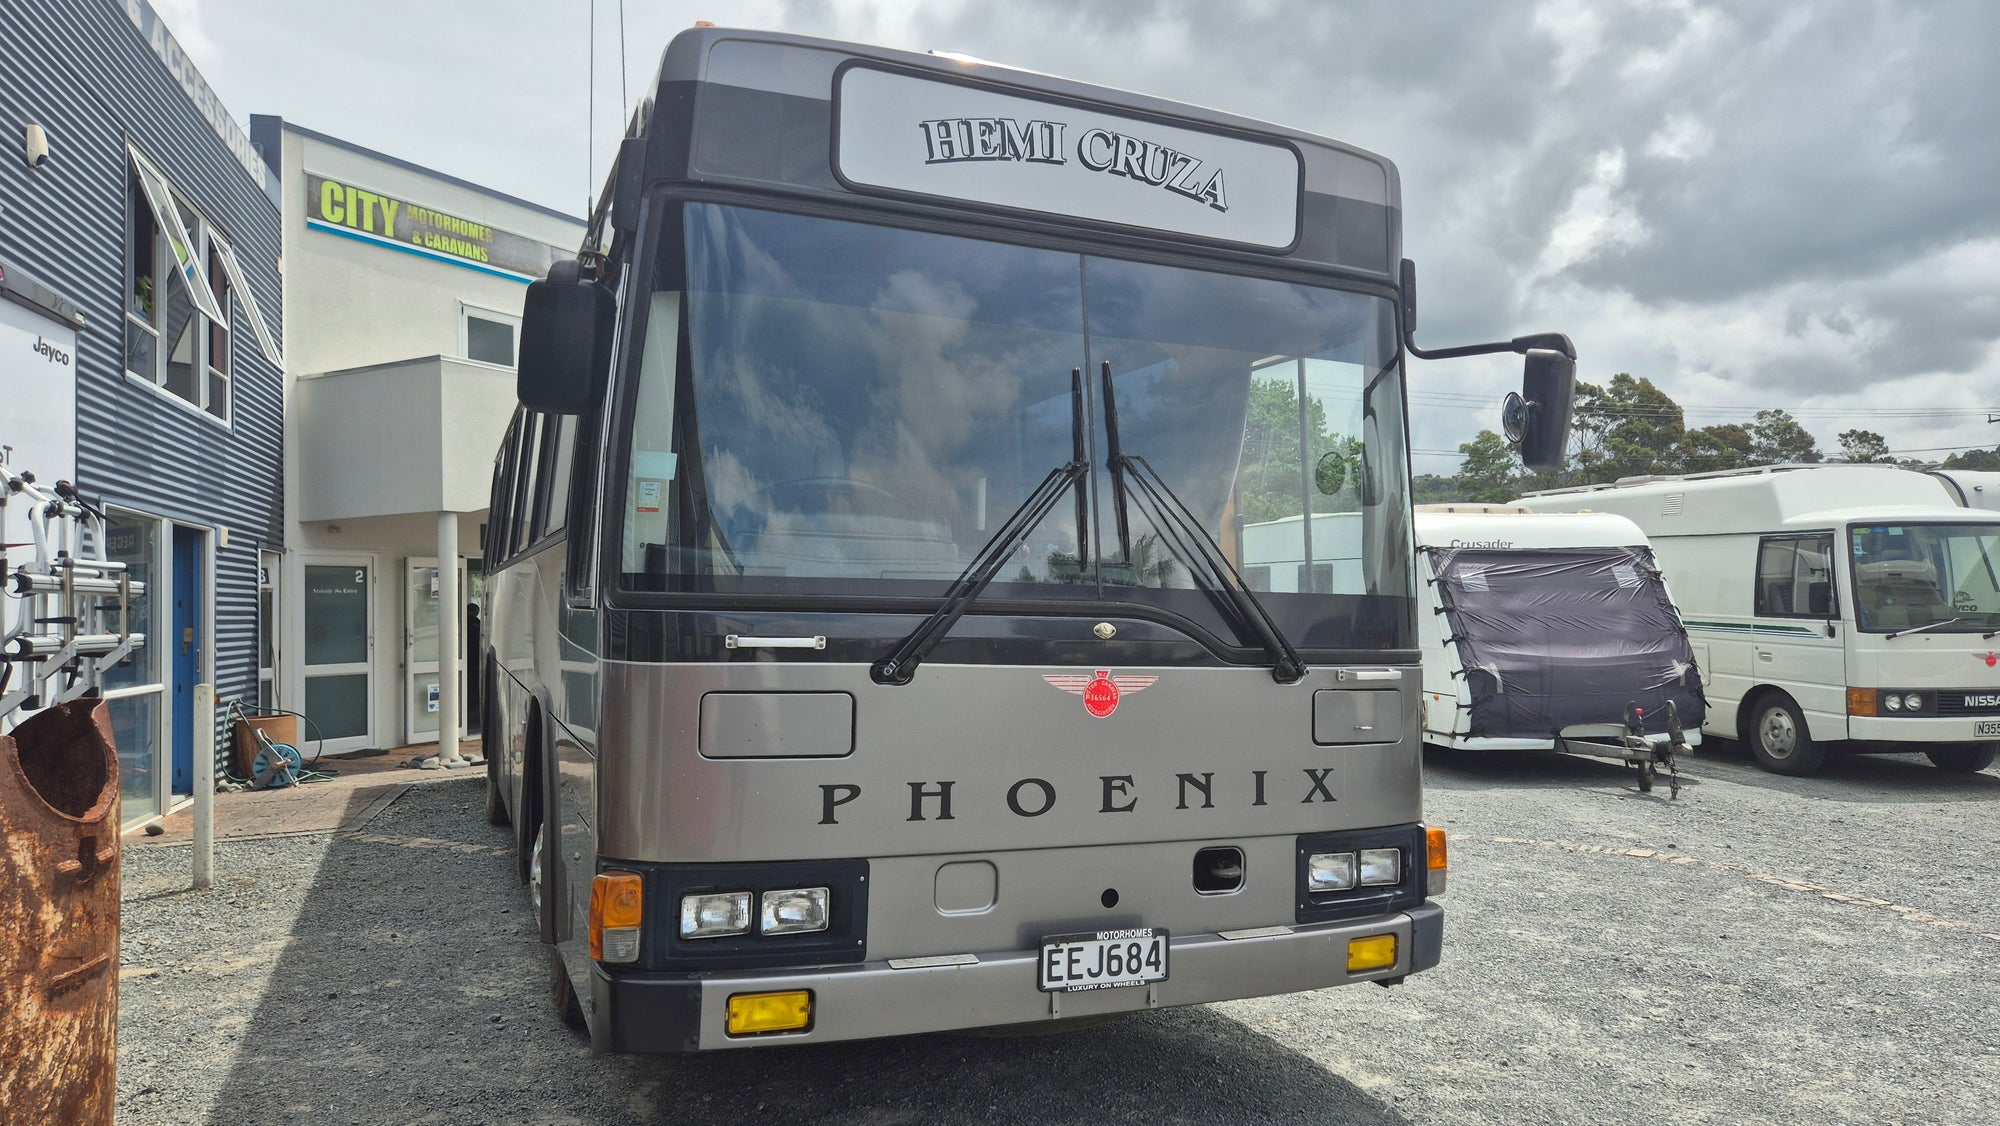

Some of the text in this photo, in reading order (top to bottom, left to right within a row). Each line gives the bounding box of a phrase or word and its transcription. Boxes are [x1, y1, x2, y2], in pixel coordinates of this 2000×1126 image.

[150, 14, 267, 191] ACCESSORIES
[919, 117, 1229, 213] HEMI CRUZA
[320, 180, 400, 238] CITY
[406, 204, 493, 244] MOTORHOMES
[412, 230, 489, 263] & CARAVANS
[33, 335, 70, 366] Jayco
[1450, 539, 1514, 550] Crusader
[355, 570, 364, 583] 2
[817, 768, 1338, 825] PHOENIX
[1096, 928, 1153, 940] MOTORHOMES
[1047, 940, 1162, 982] EEJ684
[1067, 983, 1098, 992] LUXURY
[1113, 980, 1146, 988] WHEELS
